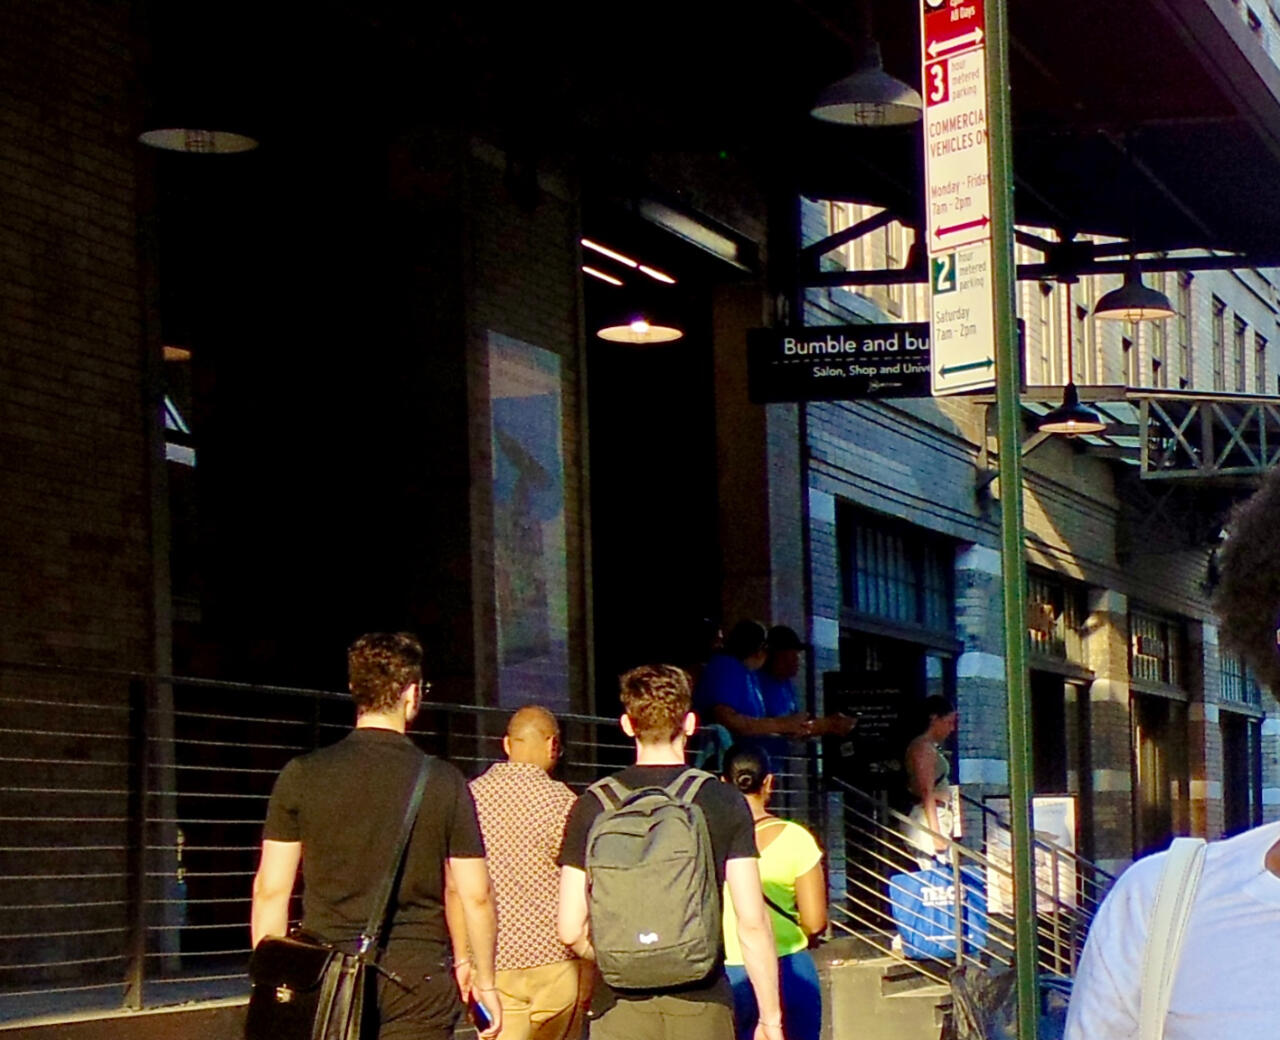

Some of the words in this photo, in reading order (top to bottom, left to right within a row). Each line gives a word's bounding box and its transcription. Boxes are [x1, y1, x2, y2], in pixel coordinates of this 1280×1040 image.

[930, 64, 944, 102] 3
[951, 68, 980, 84] metered
[952, 85, 977, 101] parking
[930, 132, 973, 158] VEHICLES
[931, 180, 960, 198] Monday
[932, 202, 948, 216] 7am
[955, 196, 972, 211] 2pm
[937, 254, 951, 291] 2
[959, 262, 986, 277] metered
[959, 277, 984, 292] parking
[936, 306, 970, 324] Saturday
[937, 328, 953, 341] 7am
[960, 323, 977, 338] 2pm
[784, 334, 857, 355] Bumble
[863, 332, 898, 352] and
[813, 365, 847, 378] Salon,
[849, 364, 878, 377] Shop
[880, 363, 900, 375] and
